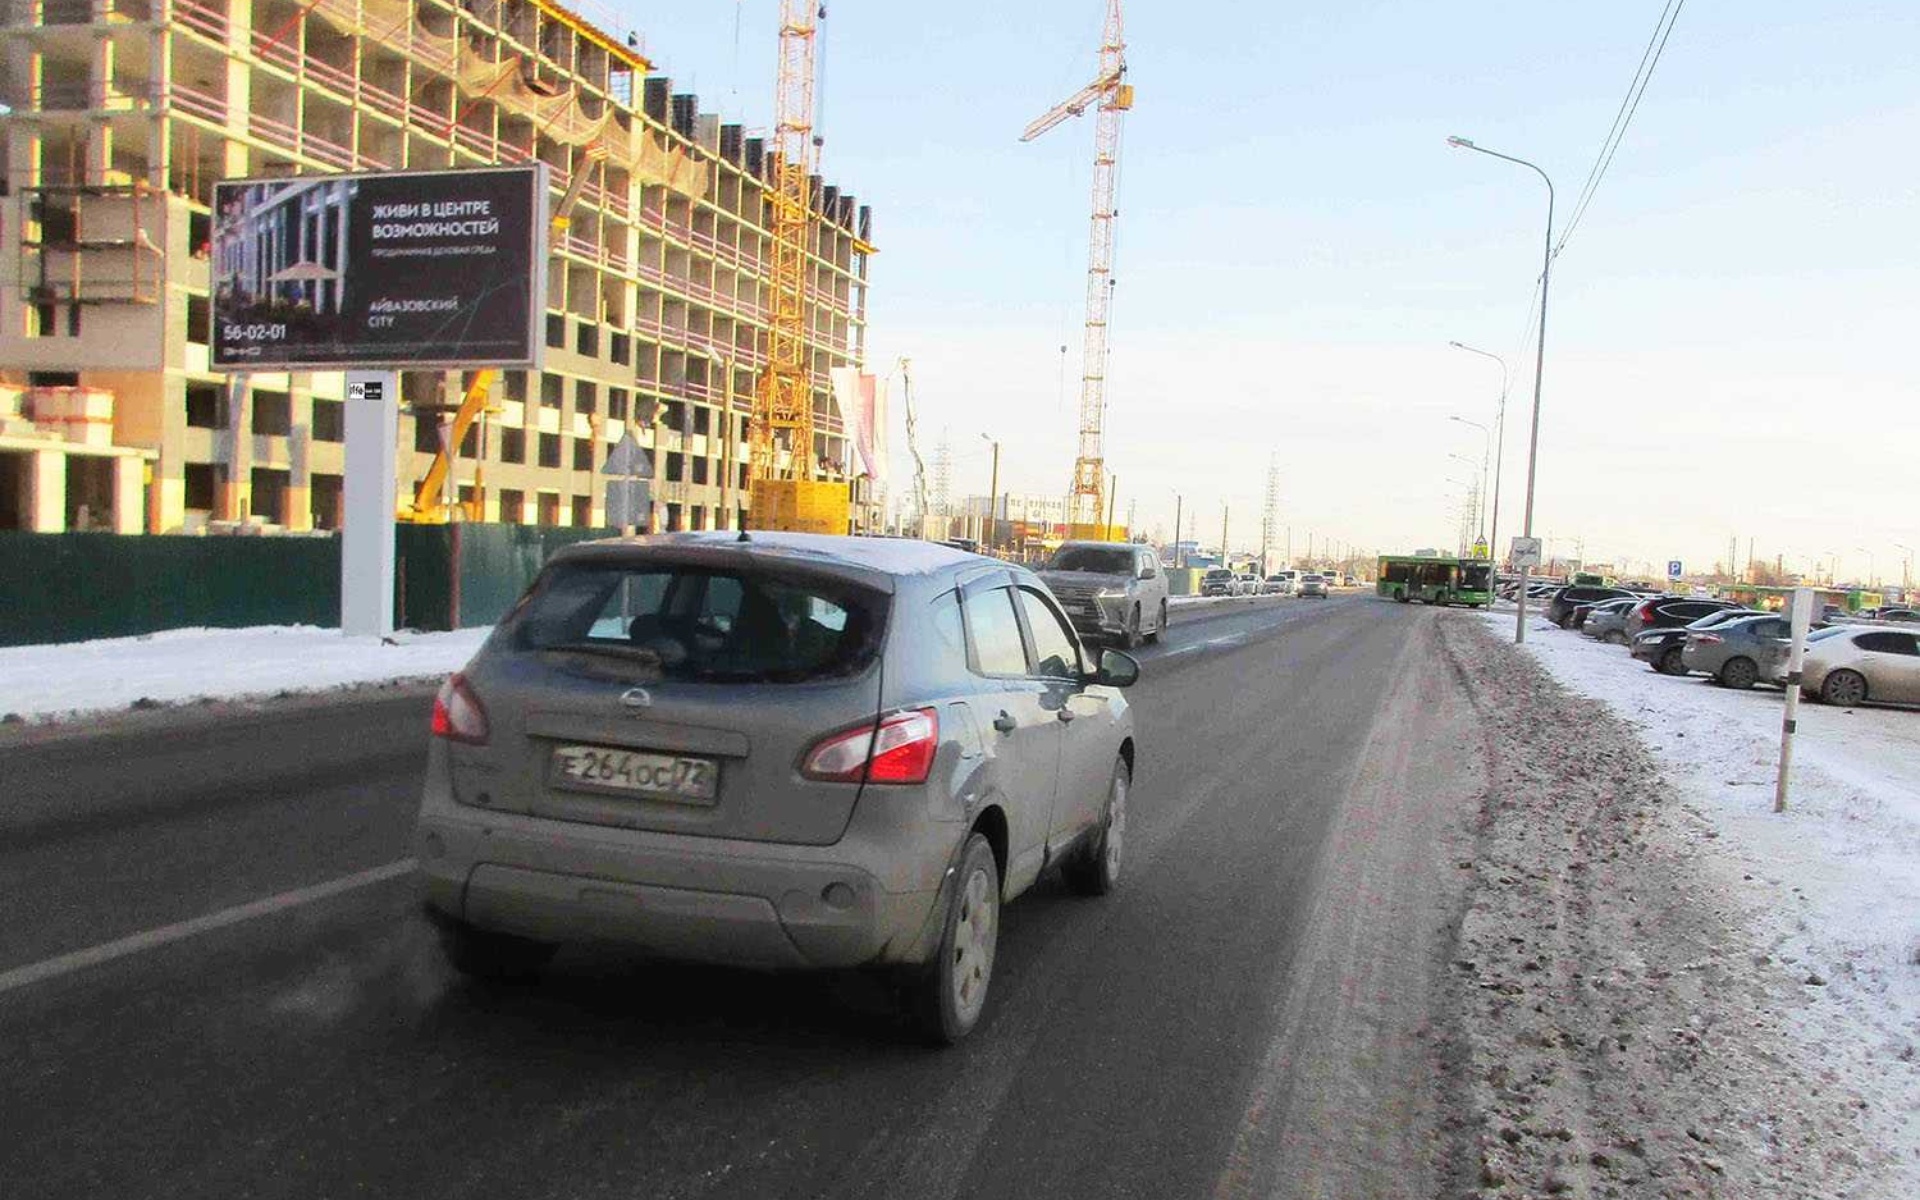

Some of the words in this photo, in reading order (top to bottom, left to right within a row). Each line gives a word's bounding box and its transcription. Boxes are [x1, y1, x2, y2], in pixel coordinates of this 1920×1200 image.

[372, 204, 419, 219] ЖИВИ
[421, 203, 431, 217] В
[433, 201, 491, 218] ЦЕНТРЕ
[372, 217, 499, 238] ВОЗМОЖНОСТЕЙ
[369, 295, 459, 312] АЙВАЗОВСКИЙ
[368, 315, 395, 328] CITY
[223, 323, 286, 340] 56-02-01
